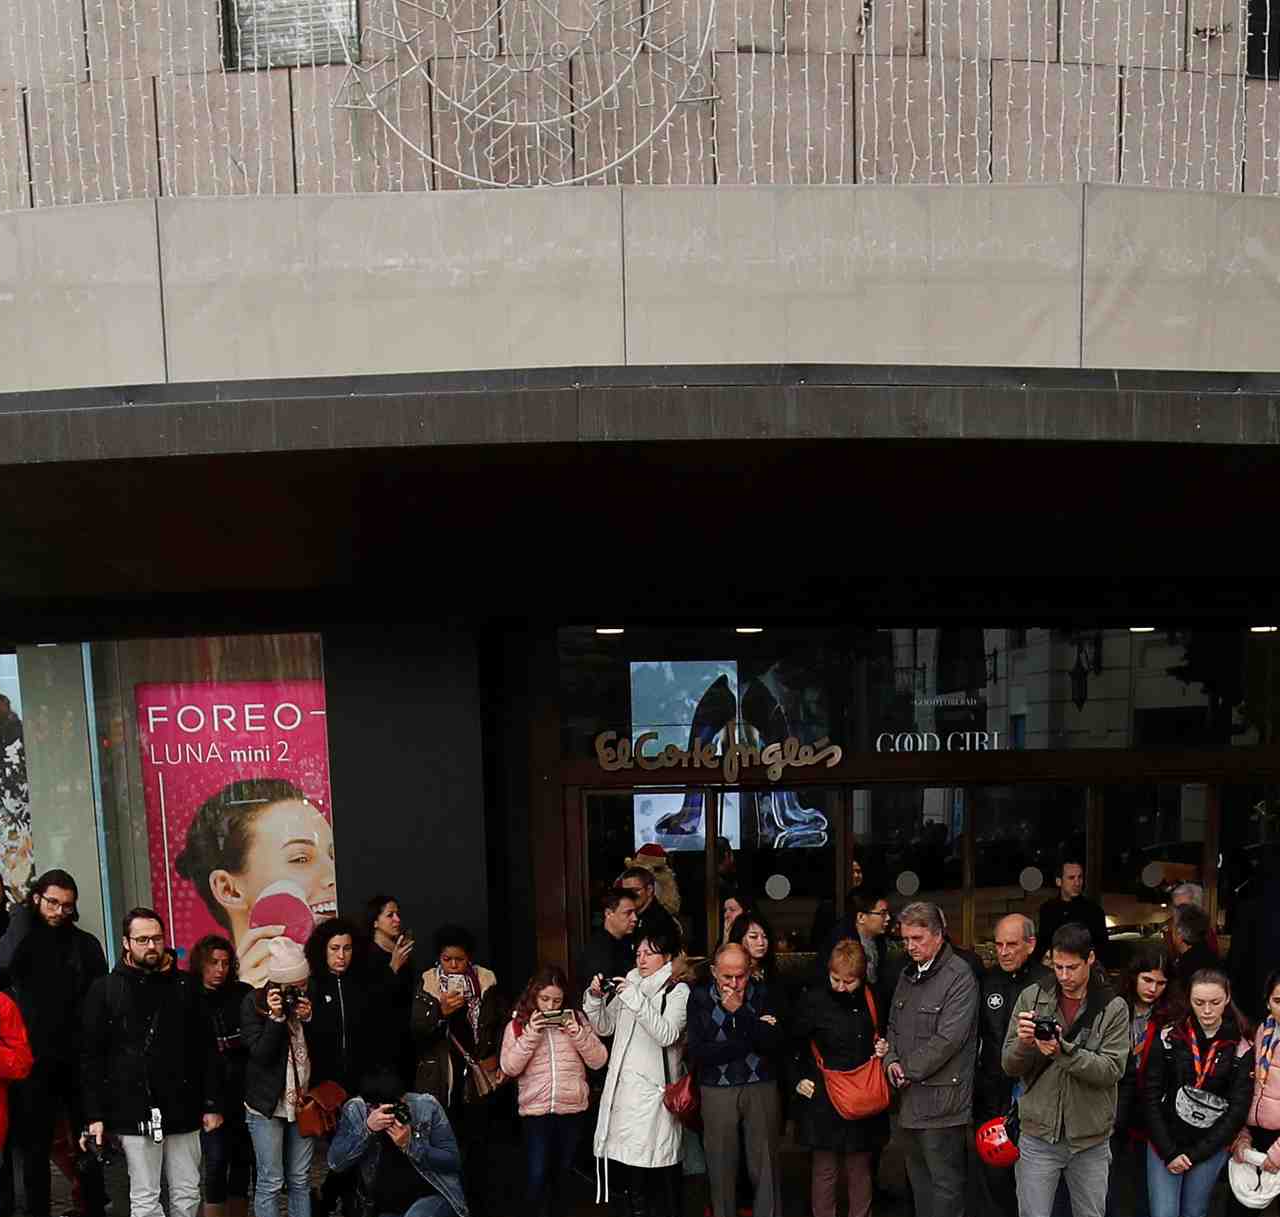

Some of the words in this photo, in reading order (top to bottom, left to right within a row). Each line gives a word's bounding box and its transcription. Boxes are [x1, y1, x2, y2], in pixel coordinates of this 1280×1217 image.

[148, 703, 302, 733] FOREO
[150, 742, 224, 765] LUNA
[230, 746, 271, 763] mini
[277, 740, 290, 762] 2
[596, 730, 634, 771] El
[634, 730, 720, 770] Corte
